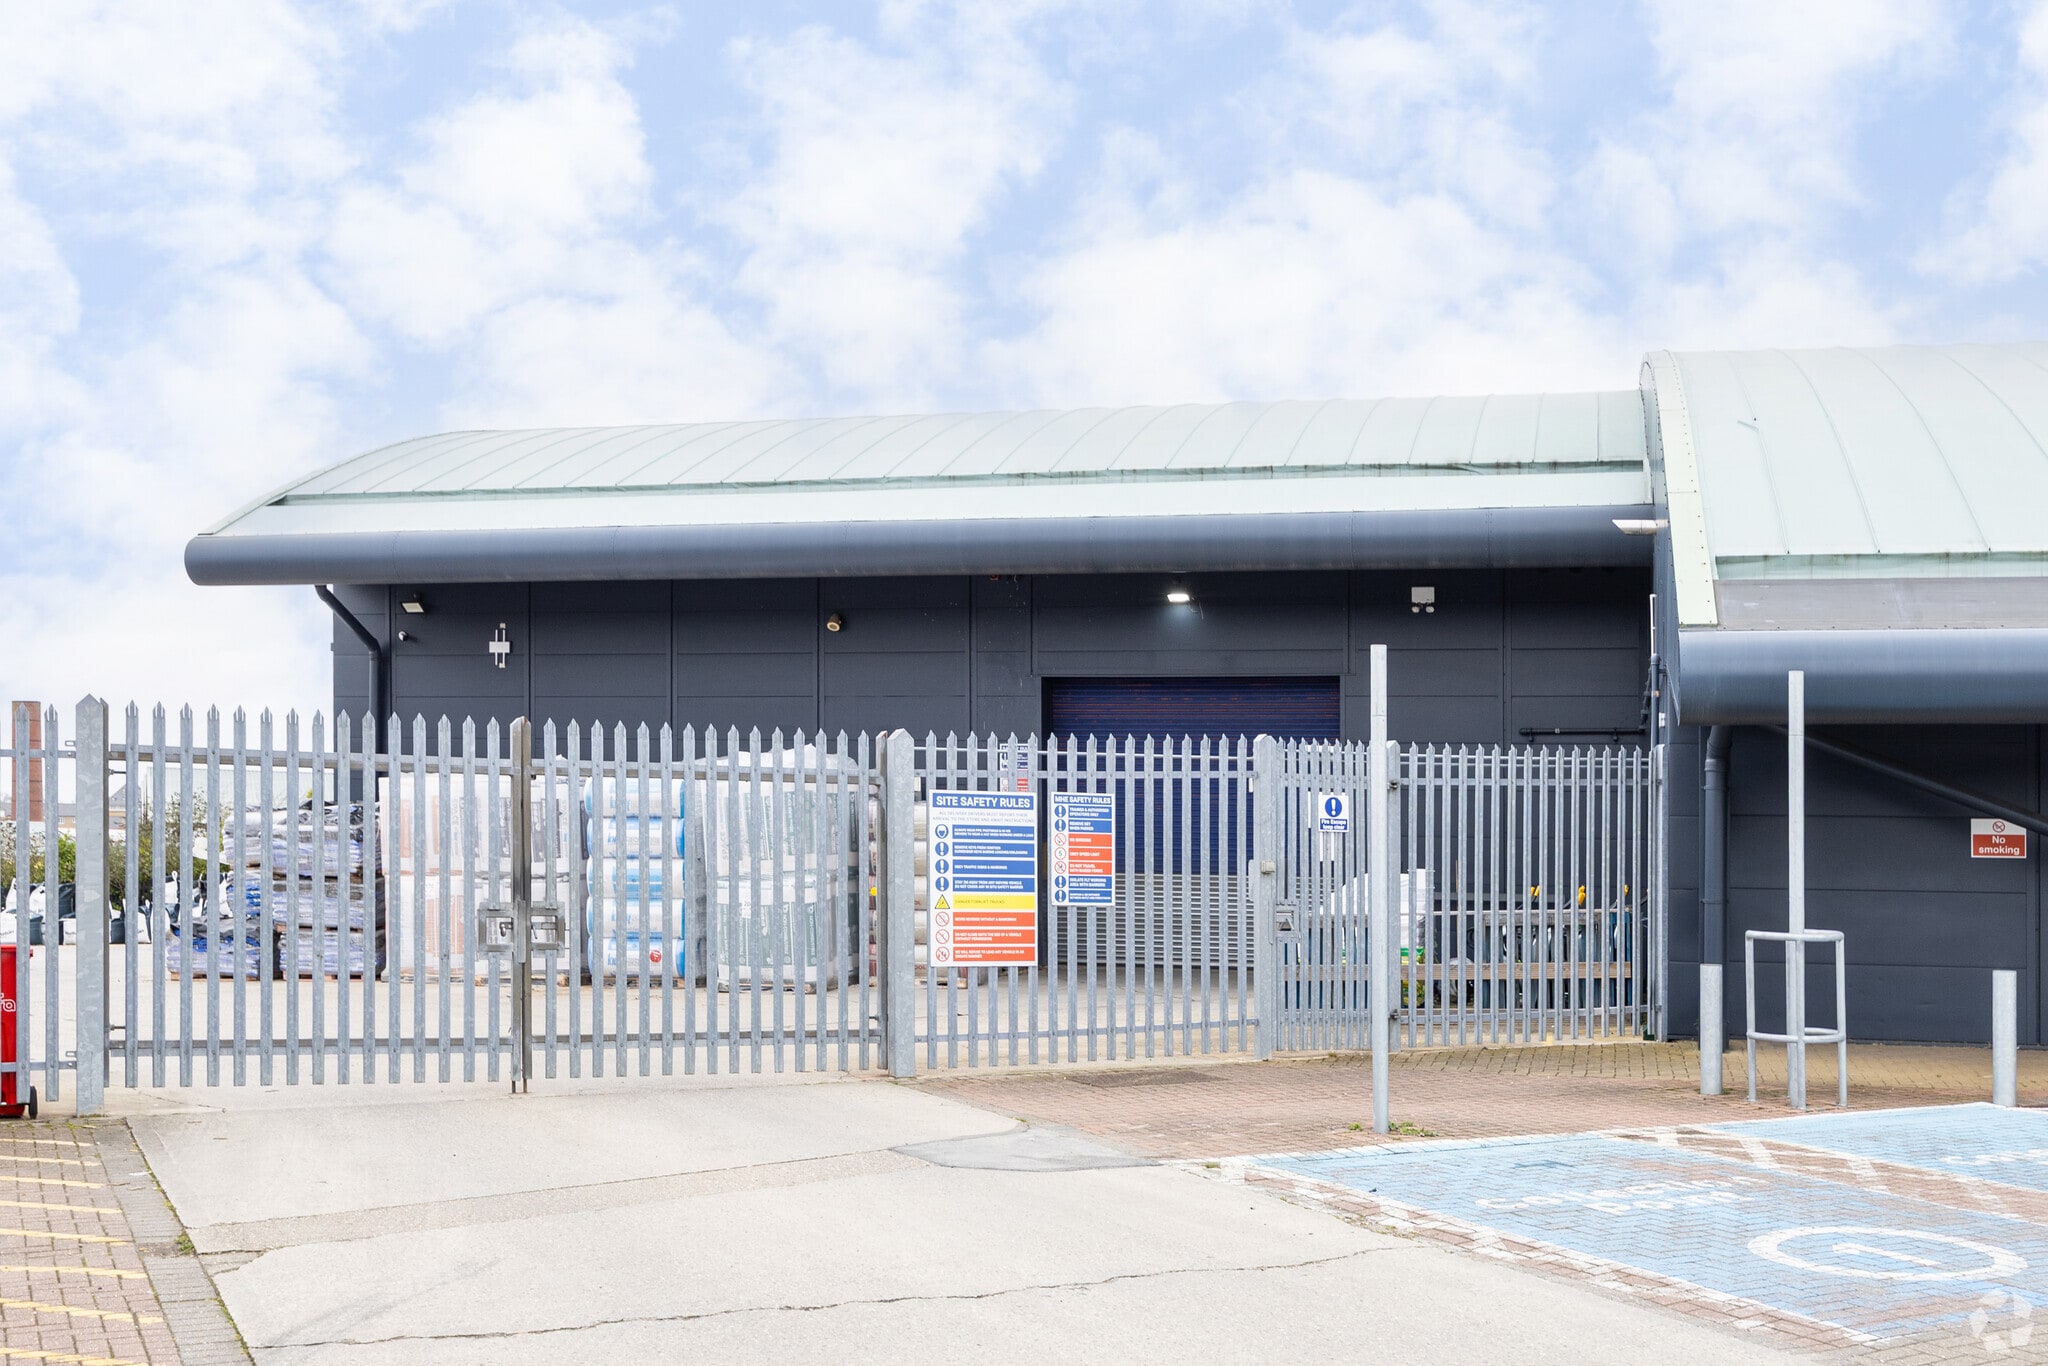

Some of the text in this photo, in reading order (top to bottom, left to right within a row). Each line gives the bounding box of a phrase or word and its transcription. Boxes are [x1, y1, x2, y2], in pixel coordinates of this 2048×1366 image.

[936, 796, 1030, 808] SITE SAFETY RULES
[1992, 836, 2006, 844] No
[1979, 845, 2020, 855] smoking
[1475, 1176, 1771, 1209] Collection
[1584, 1190, 1754, 1216] Point
